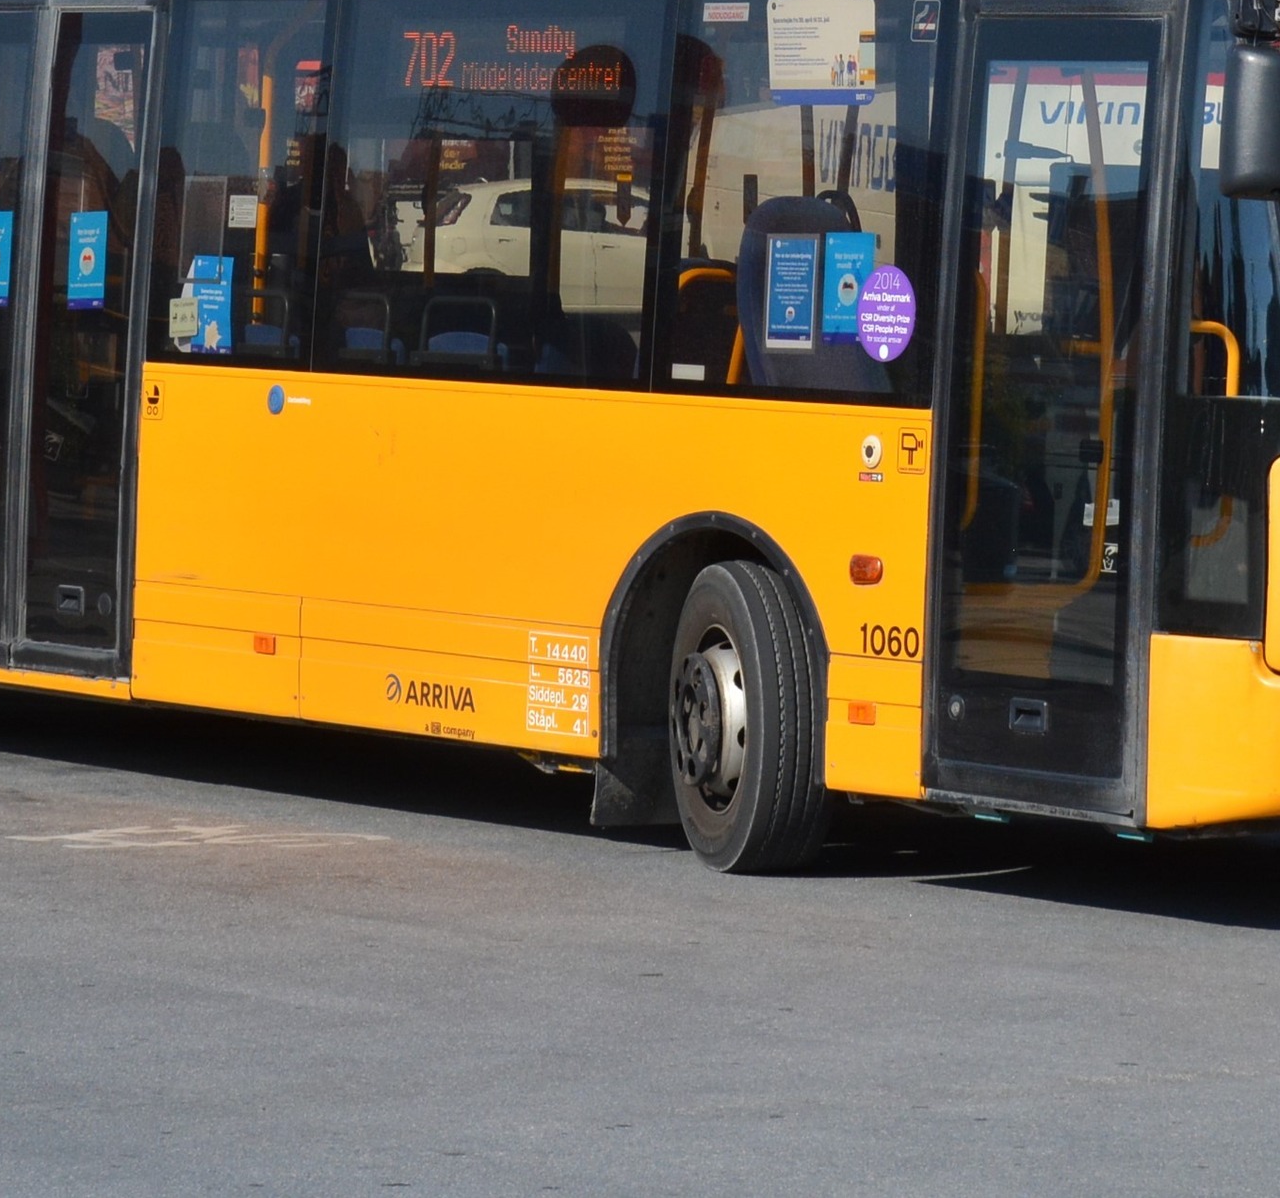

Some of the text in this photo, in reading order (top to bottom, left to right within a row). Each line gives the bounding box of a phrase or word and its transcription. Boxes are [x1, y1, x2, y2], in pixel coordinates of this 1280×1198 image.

[404, 25, 576, 87] 702 Sundby
[461, 61, 622, 91] Middelaldercentret
[874, 272, 901, 290] 2014
[863, 291, 911, 303] Arriva Danmark
[861, 313, 873, 322] CSR
[873, 313, 896, 324] Diversity
[896, 315, 911, 324] Prize
[862, 323, 908, 335] CSR People Prize
[530, 637, 588, 662] T. 14440
[860, 622, 920, 659] 1060
[531, 663, 589, 686] L. 5625
[405, 680, 475, 713] ARRIVA
[528, 685, 588, 710] Siddepl. 29
[424, 724, 430, 732] a
[442, 725, 475, 740] company
[528, 708, 588, 735] Ståpl. 41
